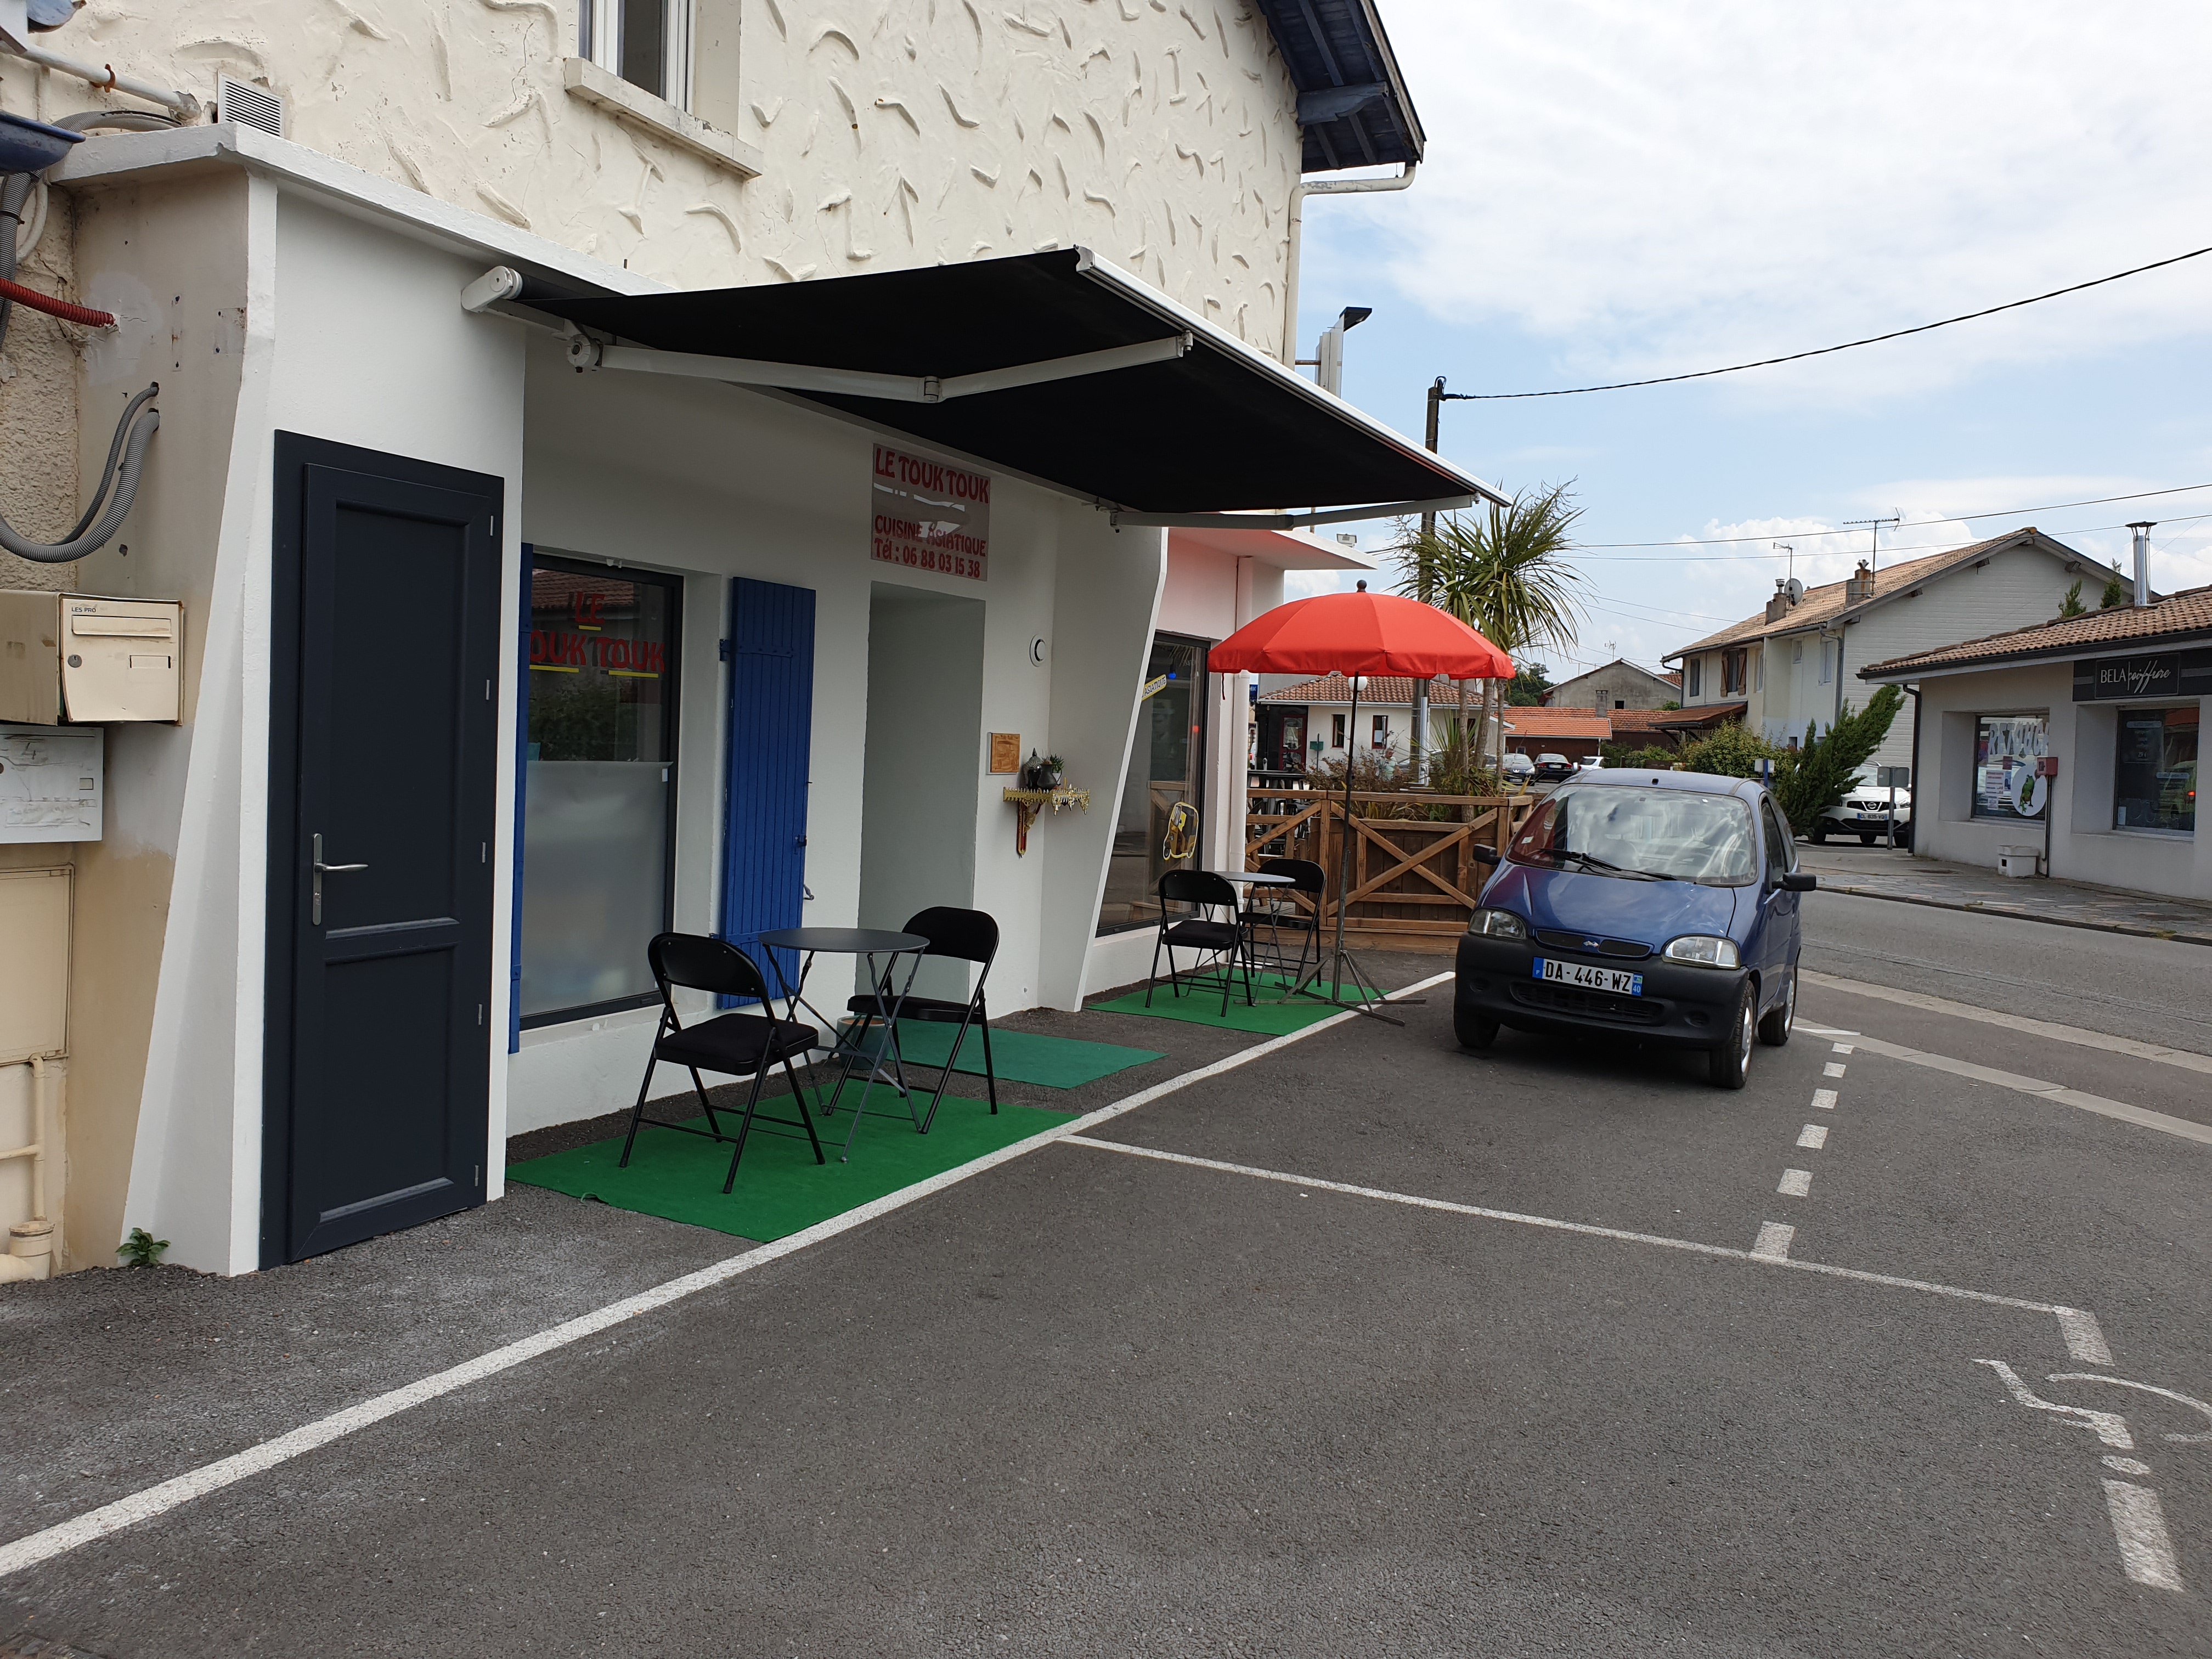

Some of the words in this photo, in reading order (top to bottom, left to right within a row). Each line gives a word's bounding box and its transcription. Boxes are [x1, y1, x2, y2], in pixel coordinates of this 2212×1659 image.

[875, 448, 895, 478] LE
[898, 456, 944, 492] TOUK
[946, 470, 989, 504] TOUK
[874, 515, 923, 543] CUISINE
[926, 529, 986, 557] ASIATIQUE
[874, 538, 892, 560] Tél
[902, 545, 917, 565] 06
[921, 549, 935, 569] 88
[938, 553, 952, 572] 03
[955, 556, 964, 575] 15
[967, 560, 980, 578] 38
[575, 591, 606, 625] LE
[529, 630, 587, 667] OUK
[595, 636, 666, 673] TOUK
[1144, 676, 1166, 697] ASIATIQUE
[2100, 668, 2126, 684] BELA
[2129, 659, 2171, 694] coiffure
[1633, 985, 1641, 993] 40
